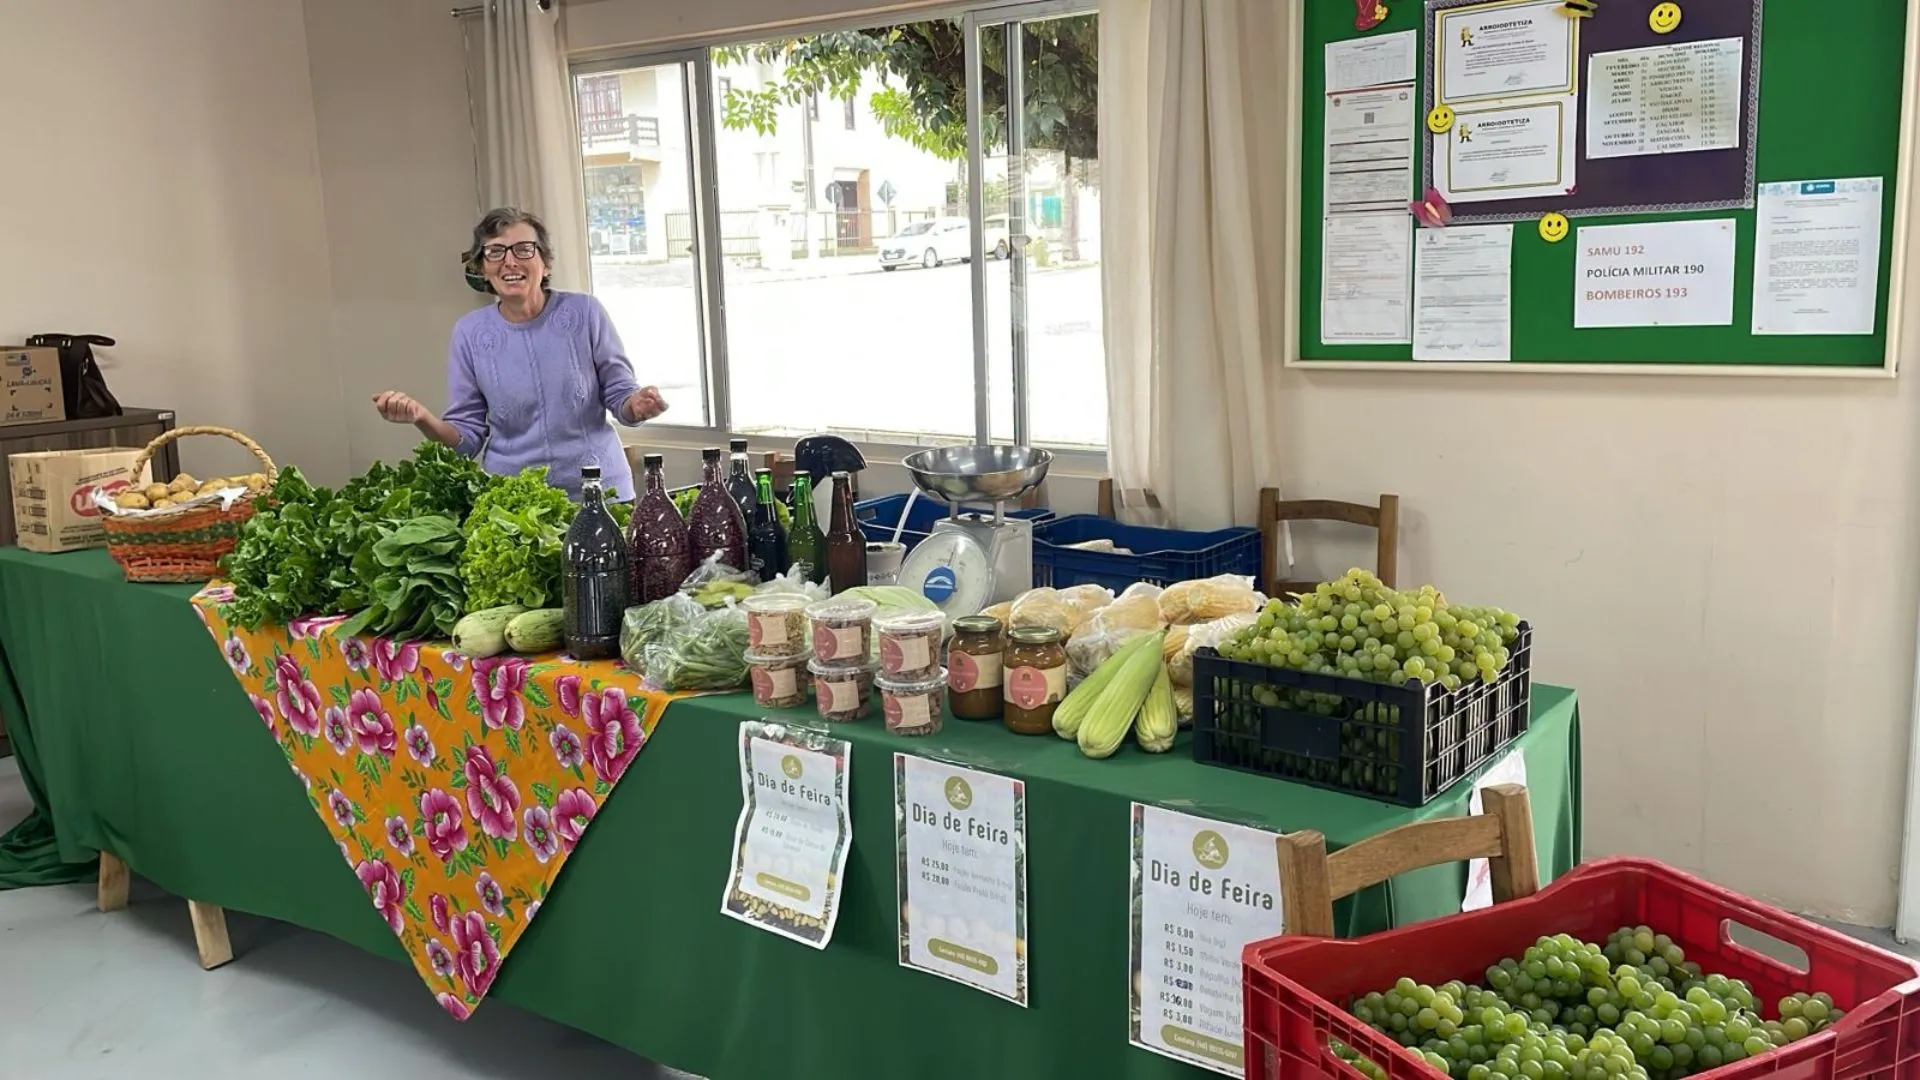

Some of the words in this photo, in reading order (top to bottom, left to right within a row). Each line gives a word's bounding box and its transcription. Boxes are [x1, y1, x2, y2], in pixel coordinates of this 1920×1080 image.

[1587, 246, 1621, 257] SAMU
[1624, 245, 1645, 255] 192
[1586, 266, 1630, 278] POLÍCIA
[1633, 265, 1680, 276] MILITAR
[1683, 264, 1704, 274] 190
[1586, 288, 1662, 300] BOMBEIROS
[1665, 287, 1688, 298] 193
[758, 772, 777, 790] Dia
[781, 780, 795, 795] de
[800, 785, 831, 806] Feira
[912, 803, 937, 826] Dia
[943, 812, 961, 833] de
[968, 817, 1008, 845] Feira
[942, 839, 960, 855] Hoje
[921, 857, 930, 867] R$
[921, 871, 930, 881] R$
[1151, 859, 1180, 887] Dia
[1189, 870, 1212, 895] de
[1221, 878, 1273, 910] Feira
[1187, 902, 1209, 919] Hoje
[1164, 923, 1174, 934] R$
[1165, 941, 1175, 952] R$
[1178, 944, 1194, 957] 1,50
[1164, 957, 1174, 969] R$
[1163, 975, 1174, 986] R$
[1160, 991, 1170, 1002] R$
[1163, 1008, 1173, 1020] R$
